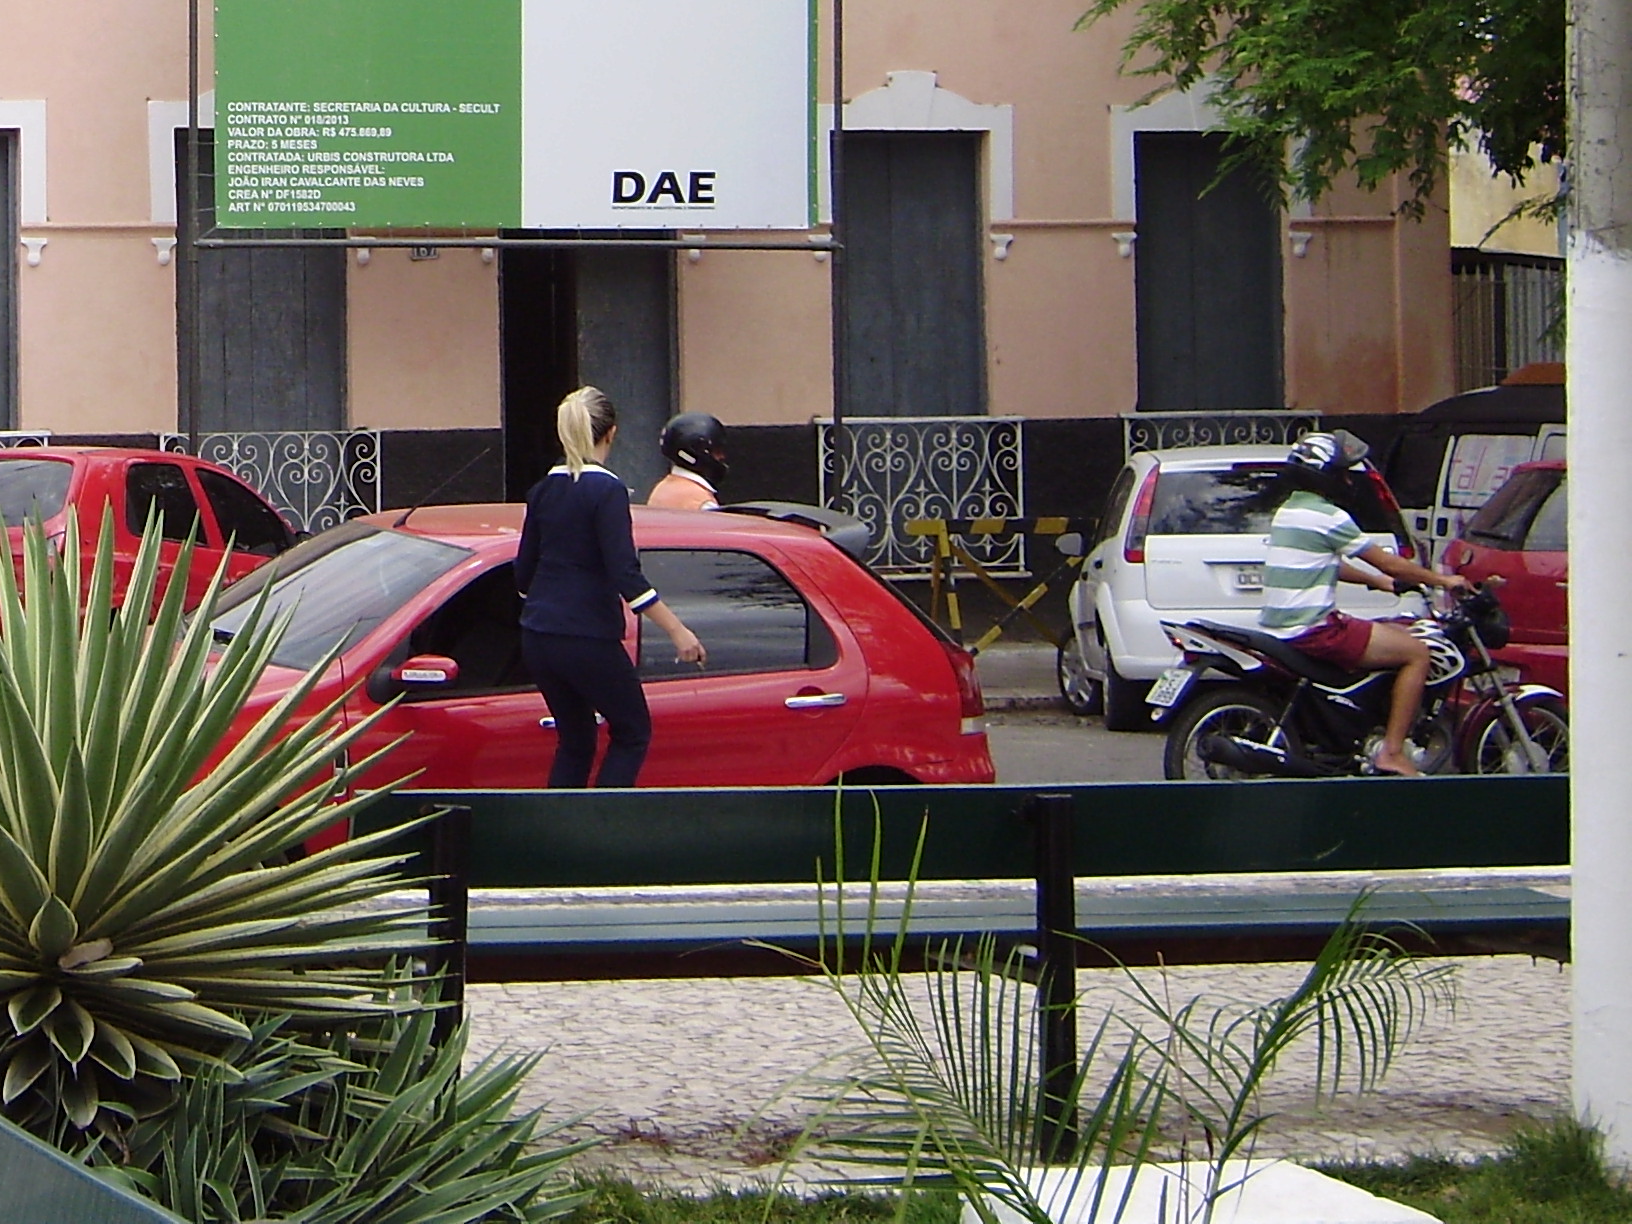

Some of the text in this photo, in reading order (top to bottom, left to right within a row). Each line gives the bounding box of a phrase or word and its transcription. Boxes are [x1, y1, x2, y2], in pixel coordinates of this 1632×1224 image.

[228, 102, 311, 112] CONTRATANTE:
[313, 102, 381, 113] SECRETARIA
[383, 103, 399, 113] DA
[400, 103, 451, 113] CULTURA
[459, 103, 501, 114] SECULT
[228, 115, 287, 125] CONTRATO
[228, 127, 264, 137] VALOR
[267, 127, 283, 137] DA
[285, 127, 320, 137] OBRA:
[322, 127, 336, 137] R$
[228, 139, 317, 149] PRAZO: 5 MESES
[228, 152, 455, 162] CONTRATADA: URBIS CONSTRUTORA LTDA
[228, 163, 386, 175] ENGENHEIRO RESPONSÁVEL:
[228, 176, 425, 187] JOÃO IRAN CAVALCANTE DAS NEVES
[612, 171, 716, 204] DAE
[228, 189, 259, 199] CREA
[228, 202, 250, 212] ART
